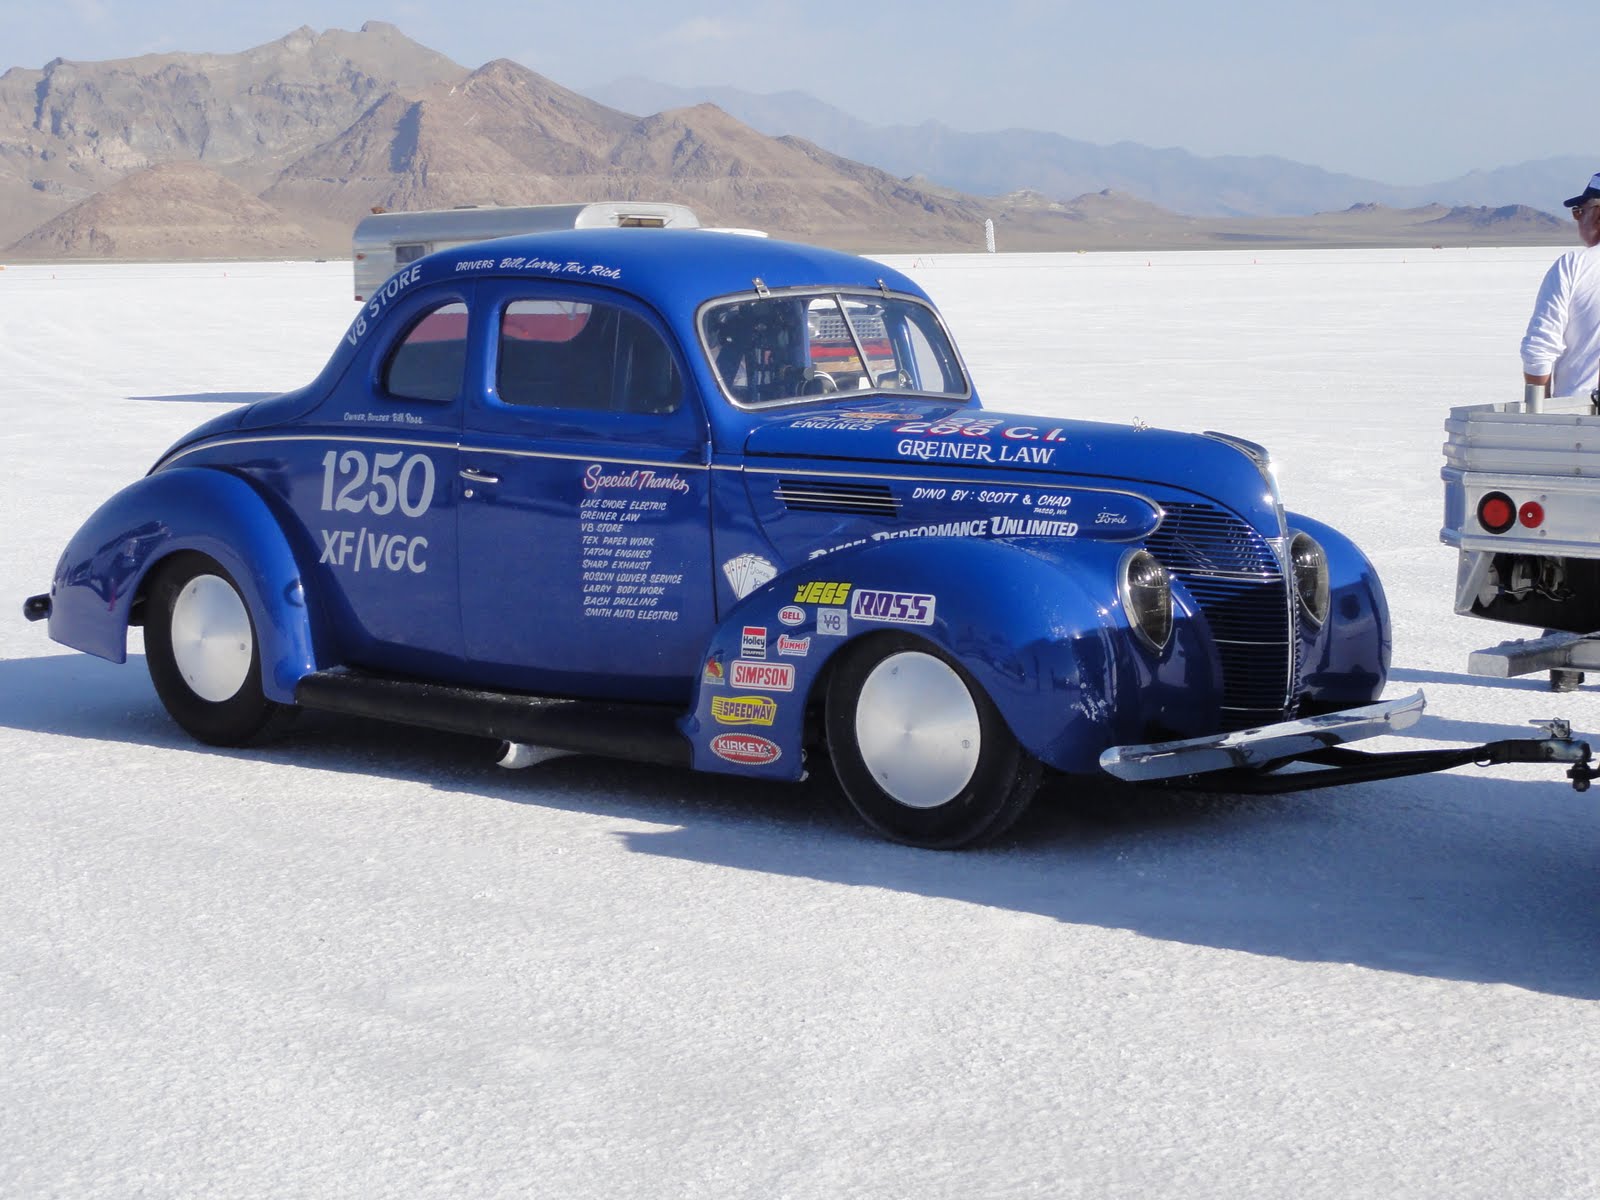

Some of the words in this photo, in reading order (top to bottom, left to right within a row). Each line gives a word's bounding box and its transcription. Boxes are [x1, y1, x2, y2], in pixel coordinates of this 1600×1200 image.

[456, 259, 494, 272] DRIVERS
[499, 258, 524, 271] Bill,
[525, 257, 562, 274] Larry,
[562, 261, 587, 276] Tex,
[588, 265, 622, 280] Rich
[347, 323, 368, 348] V8
[369, 264, 423, 319] STORE
[790, 420, 877, 431] ENGINES
[1001, 426, 1067, 442] C.I.
[897, 439, 997, 463] GREINER
[999, 445, 1056, 464] LAW
[320, 450, 436, 518] 1250
[582, 464, 639, 494] Special
[638, 470, 690, 495] Thanks
[912, 487, 946, 500] DYNO
[977, 490, 1019, 504] SCOTT
[1022, 494, 1032, 506] &
[1037, 494, 1072, 508] CHAD
[580, 499, 601, 508] LAKE
[601, 499, 627, 510] SHORE
[629, 500, 668, 511] ELECTRIC
[580, 511, 618, 522] GREINER
[620, 512, 641, 522] LAW
[1094, 512, 1128, 524] Ford
[581, 523, 594, 532] V8
[596, 523, 624, 533] STORE
[990, 516, 1079, 537] UNLIMITED
[582, 536, 599, 545] TEX
[602, 536, 627, 546] PAPER
[630, 537, 655, 546] WORK
[319, 527, 429, 574] XF/VGC
[583, 548, 613, 557] TATOM
[614, 549, 652, 559] ENGINES
[582, 559, 608, 569] SHARP
[611, 560, 652, 570] EXHAUST
[583, 572, 614, 582] ROSLYN
[616, 572, 647, 584] LOUVER
[649, 574, 683, 584] SERVICE
[583, 584, 612, 593] LARRY
[616, 585, 638, 594] BODY
[640, 586, 666, 596] WORK
[794, 582, 852, 605] JEGS
[583, 596, 610, 606] BACH
[612, 597, 658, 606] DRILLING
[854, 591, 932, 620] ROSS
[584, 608, 612, 618] SMITH
[613, 608, 635, 619] AUTO
[637, 610, 679, 621] ELECTRIC
[782, 611, 801, 621] BELL
[824, 614, 841, 630] V8
[742, 636, 765, 648] Holley
[735, 665, 789, 686] SIMPSON
[722, 701, 773, 720] SPEEDWAY
[718, 739, 765, 752] KIRKEY
